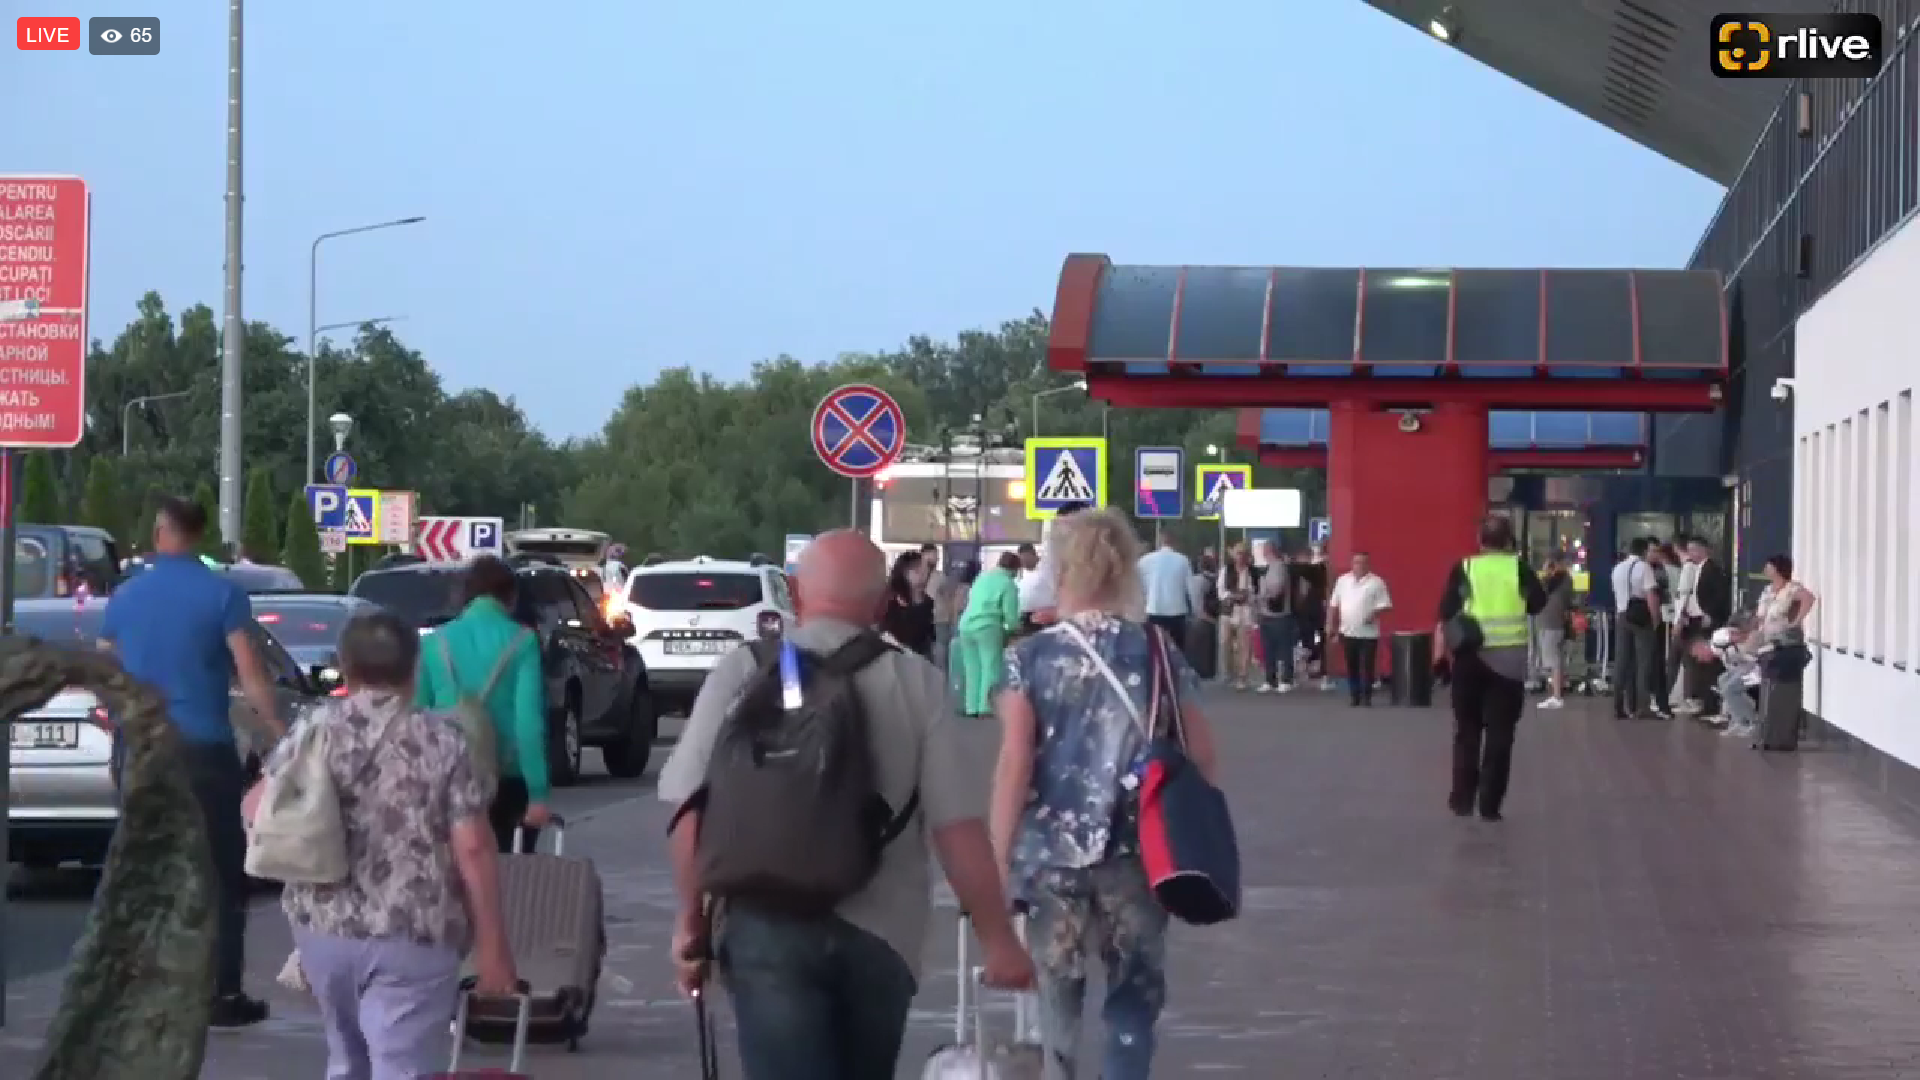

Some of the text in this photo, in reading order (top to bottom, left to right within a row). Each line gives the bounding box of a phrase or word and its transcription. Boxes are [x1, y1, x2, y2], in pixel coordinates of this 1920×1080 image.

[0, 183, 58, 200] PENTRU
[0, 323, 79, 340] СТАНОВКИ
[315, 491, 339, 523] P
[474, 524, 491, 548] P
